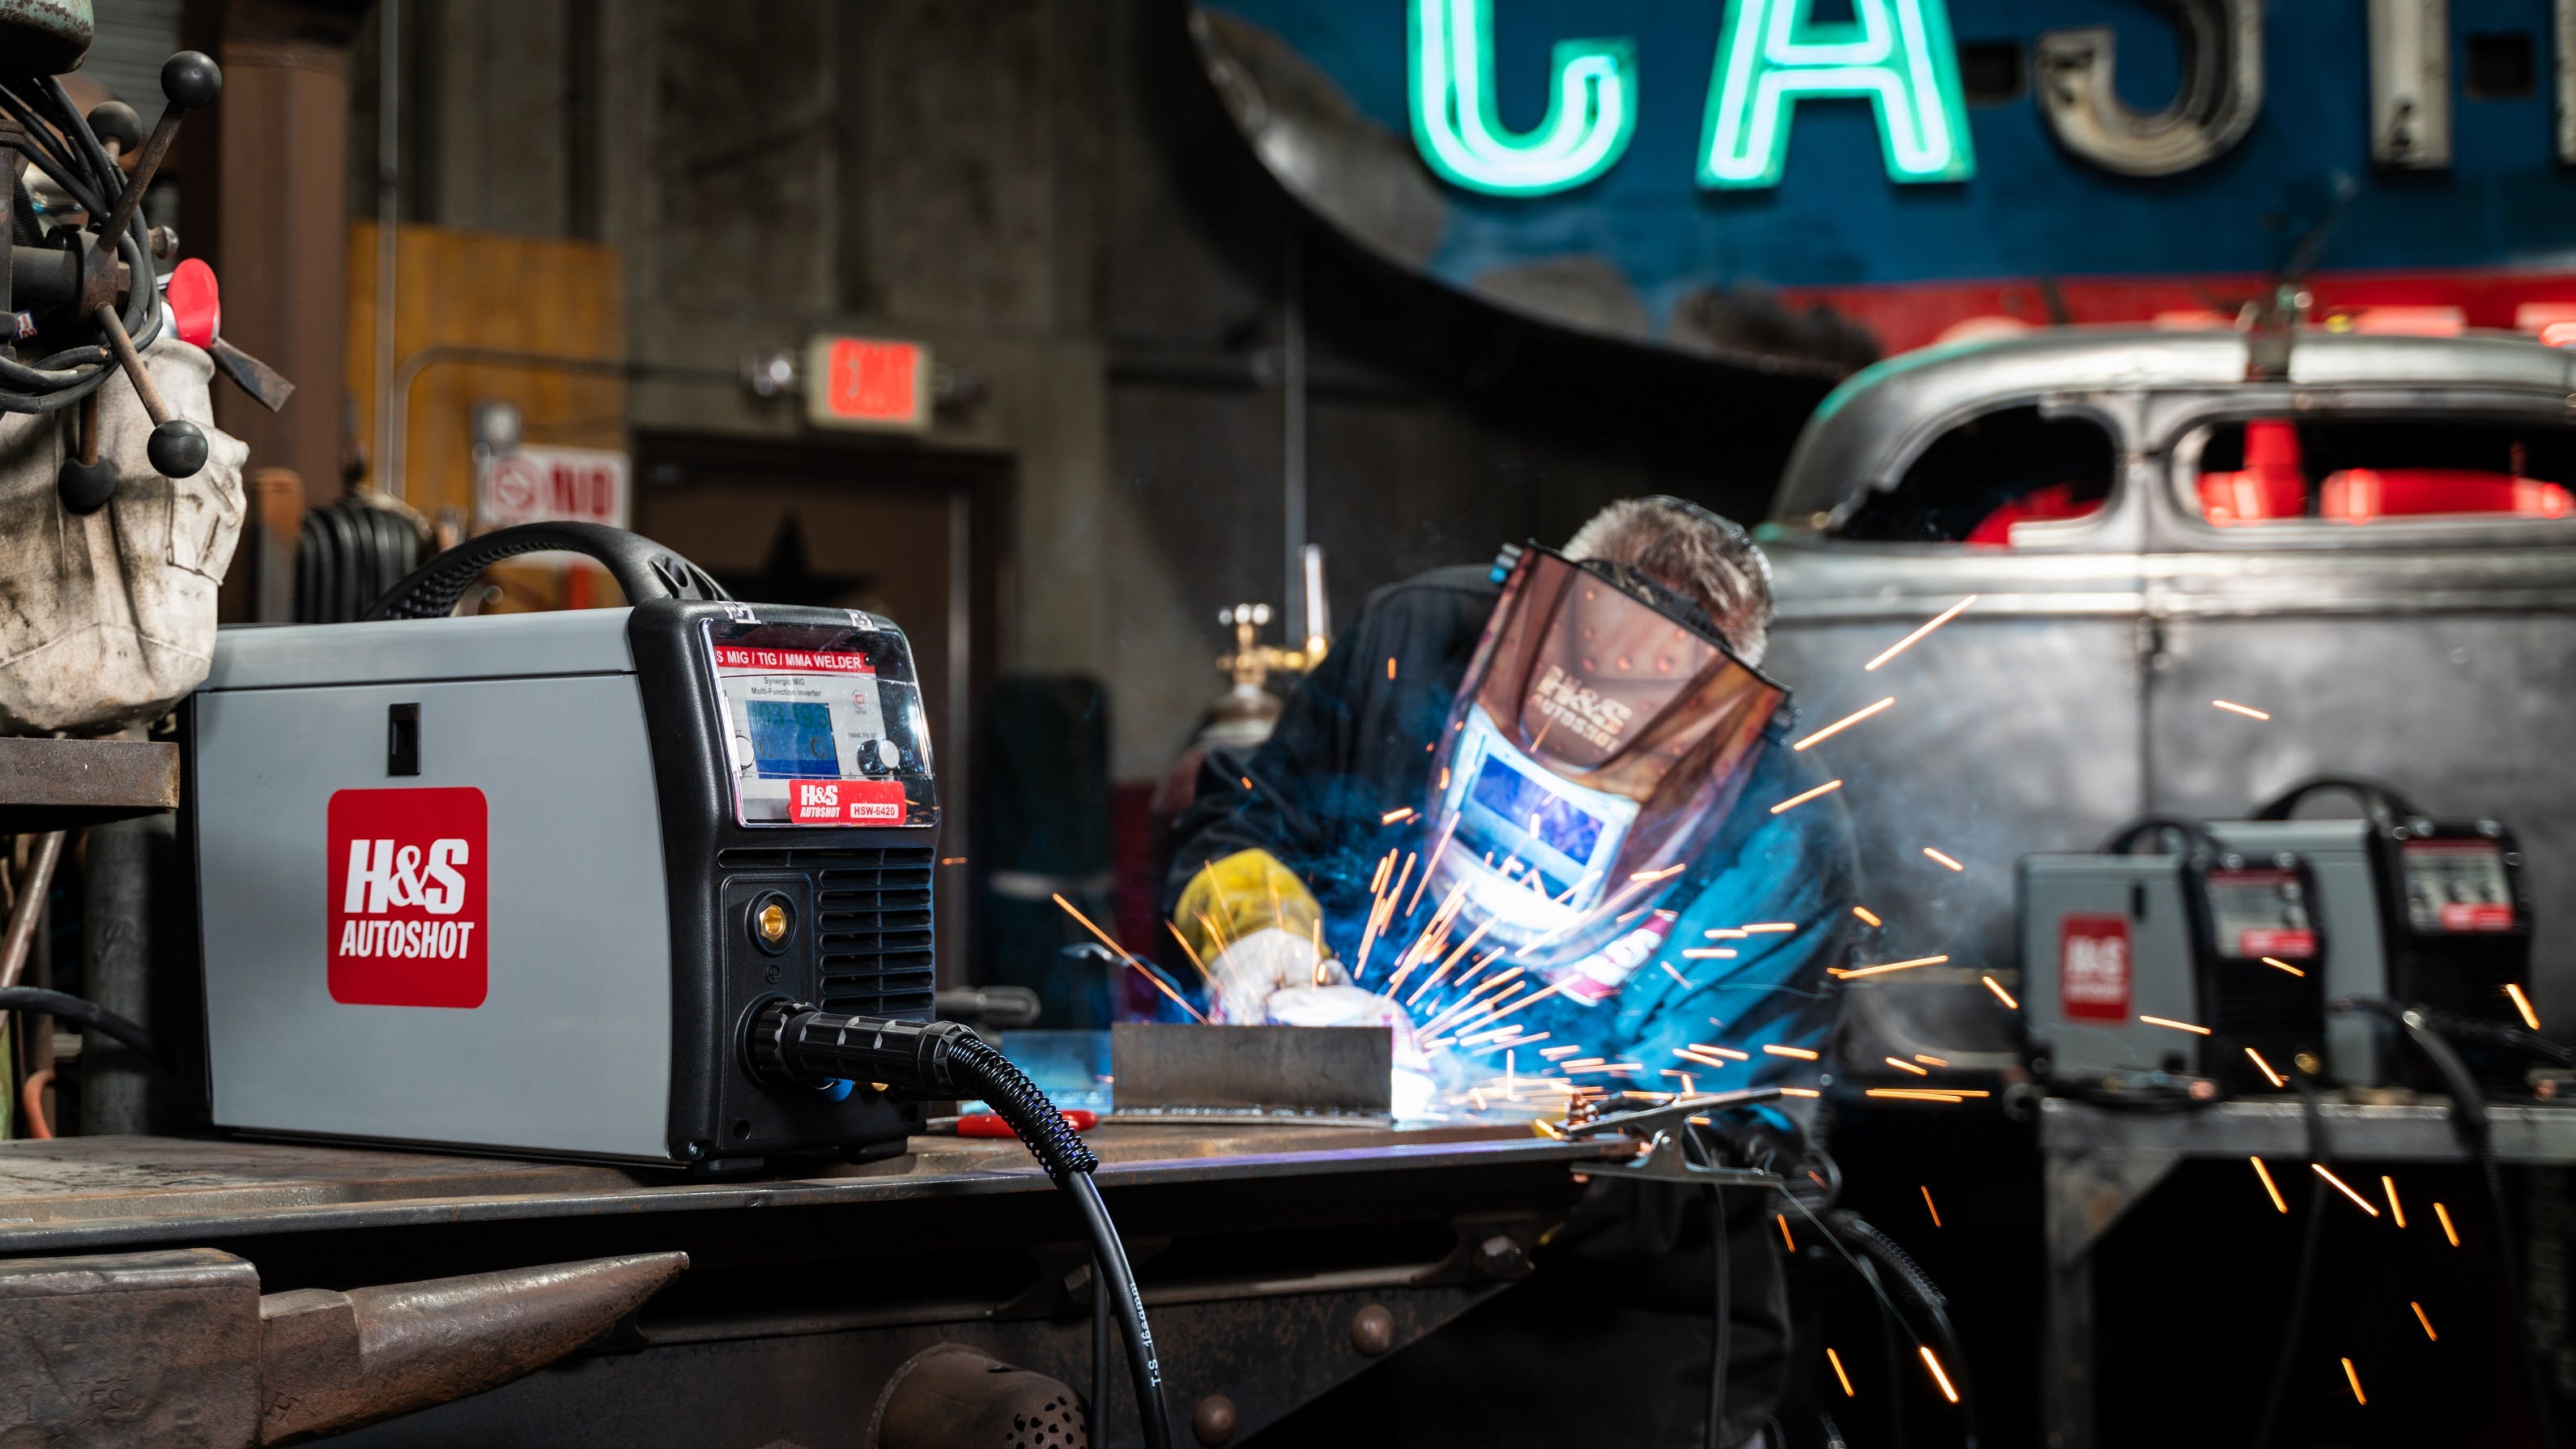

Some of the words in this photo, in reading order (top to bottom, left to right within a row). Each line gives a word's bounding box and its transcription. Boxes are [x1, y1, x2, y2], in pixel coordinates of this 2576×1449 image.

[727, 650, 749, 664] MIG
[752, 652, 756, 664] /
[757, 652, 777, 665] TIG
[779, 654, 783, 666] /
[785, 654, 811, 667] MMA
[813, 654, 862, 670] WELDER
[764, 676, 790, 687] Synergic
[752, 687, 796, 697] Multi-Function
[800, 785, 838, 806] H&S
[799, 806, 841, 818] AUTOSHOT
[854, 806, 895, 816] HSW-6420
[344, 838, 469, 914] H&S
[338, 920, 475, 959] AUTOSHOT
